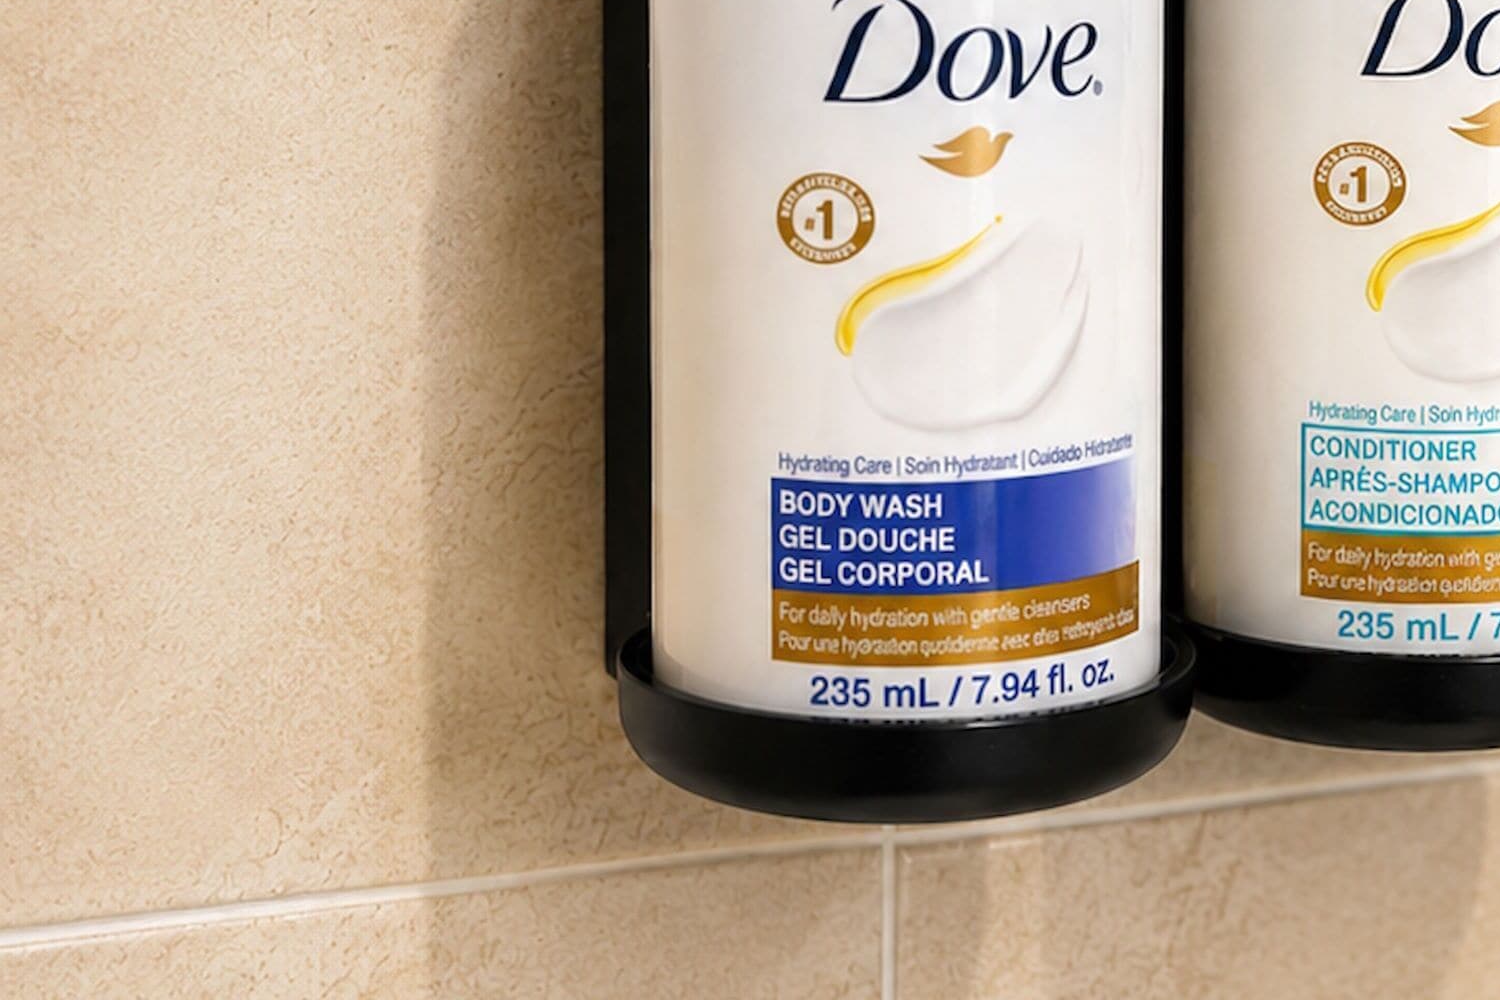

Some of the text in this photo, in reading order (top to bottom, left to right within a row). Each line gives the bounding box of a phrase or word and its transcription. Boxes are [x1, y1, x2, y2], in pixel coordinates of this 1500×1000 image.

[1309, 400, 1377, 425] Hydrating
[1380, 405, 1416, 422] Care
[1429, 405, 1463, 423] Soin
[1310, 436, 1477, 461] CONDITIONER
[779, 453, 850, 478] Hydrating
[854, 456, 892, 475] Care
[905, 456, 941, 475] Soin
[944, 453, 1019, 478] Hydratant
[780, 489, 943, 518] BODY WASH
[780, 524, 955, 552] GEL DOUCHE
[1308, 541, 1333, 562] For
[780, 557, 990, 586] GEL CORPORAL
[779, 601, 807, 624] For
[808, 604, 847, 632] daily
[850, 606, 928, 632] hydration
[932, 605, 968, 627] with
[1337, 610, 1394, 639] 235
[1407, 612, 1459, 640] mL
[810, 677, 871, 707] 235
[884, 678, 939, 708] mL
[972, 669, 1039, 704] 7.94
[1047, 663, 1073, 696] fl.
[1082, 659, 1114, 688] oz.
